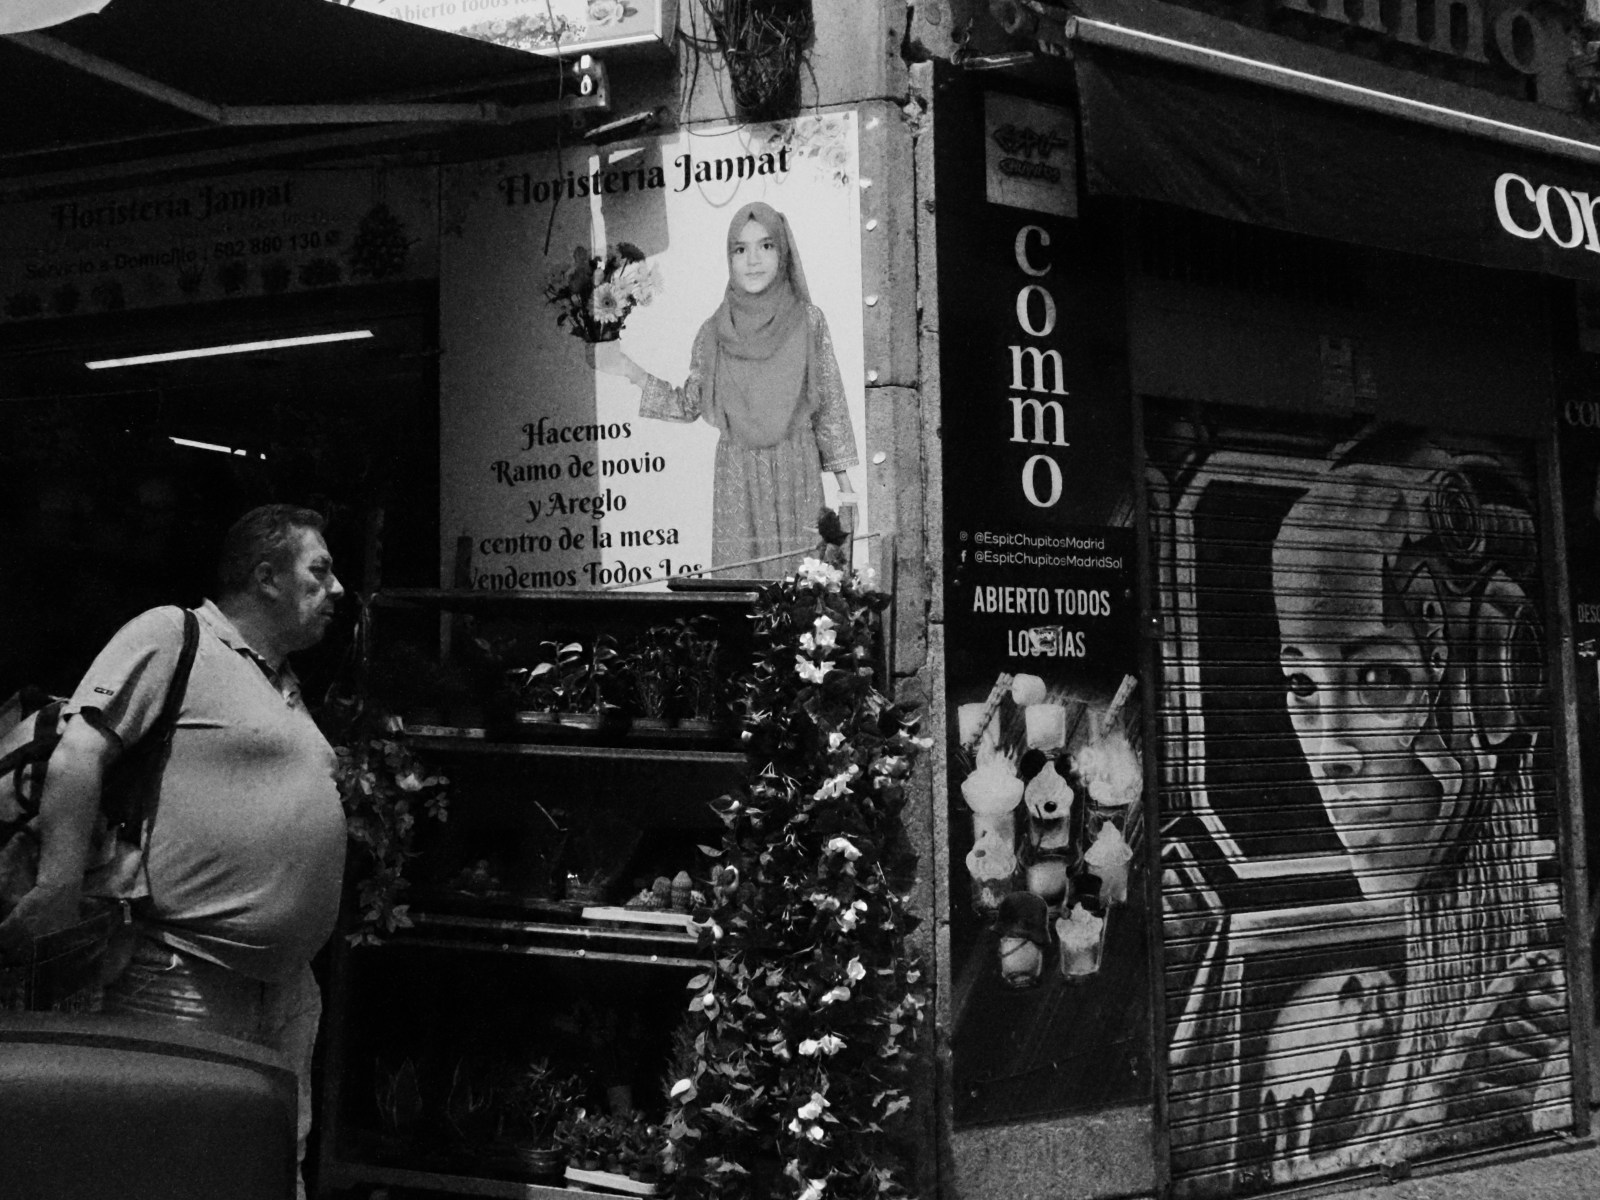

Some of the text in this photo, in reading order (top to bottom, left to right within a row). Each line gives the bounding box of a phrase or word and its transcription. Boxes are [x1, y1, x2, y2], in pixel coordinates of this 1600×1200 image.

[674, 145, 792, 193] Jannat
[289, 231, 320, 250] 130
[521, 417, 632, 450] Hacemos
[491, 452, 665, 486] Ramo de novio
[526, 489, 626, 523] y Areglo
[480, 525, 679, 555] centro de la mesa
[974, 531, 1105, 549] @EspitChupitosMadrid
[583, 560, 652, 585] Todos
[974, 551, 1123, 569] @EspitChupitosMadridSol
[973, 585, 1110, 616] ABIERTO TODOS
